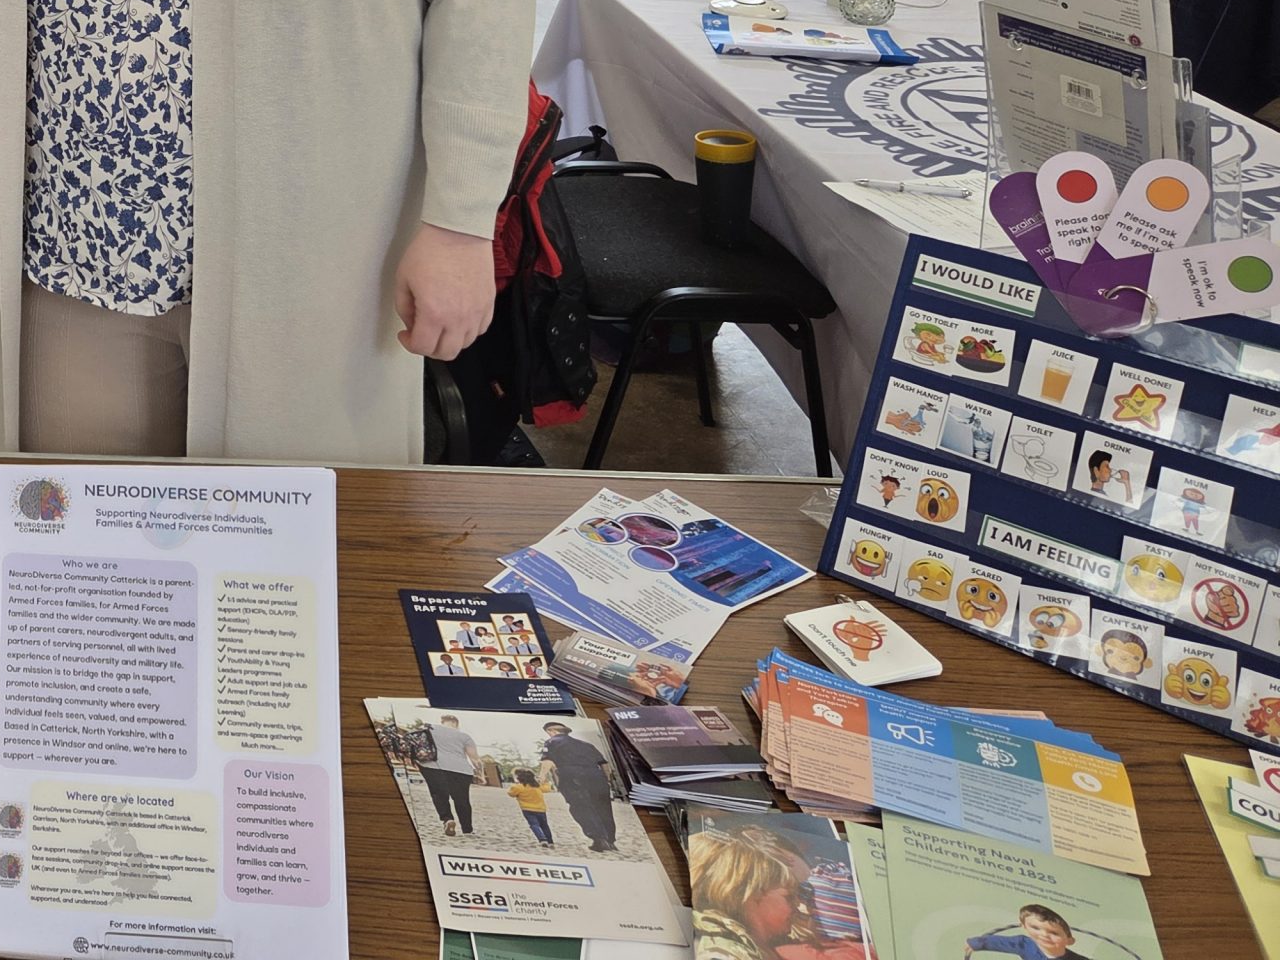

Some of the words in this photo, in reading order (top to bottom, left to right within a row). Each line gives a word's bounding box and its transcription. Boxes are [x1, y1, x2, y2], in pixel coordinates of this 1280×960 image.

[1124, 211, 1158, 233] Please
[1159, 226, 1178, 239] ask
[1116, 220, 1132, 233] me
[1160, 238, 1175, 250] ok
[920, 260, 926, 272] I
[932, 263, 994, 290] WOULD
[999, 282, 1035, 302] LIKE
[1183, 258, 1200, 287] speak
[1192, 289, 1204, 308] now
[1202, 279, 1214, 295] ok
[909, 311, 920, 319] GO
[922, 314, 932, 322] TO
[934, 317, 959, 329] TOILET
[971, 327, 994, 336] MORE
[1051, 350, 1074, 361] JUICE
[1120, 369, 1142, 382] WELL
[1143, 376, 1172, 389] DONE!
[893, 381, 916, 392] WASH
[916, 388, 944, 403] HANDS
[965, 402, 992, 417] WATER
[1252, 406, 1276, 417] HELP
[1027, 424, 1054, 438] TOILET
[1104, 441, 1132, 455] DRINK
[870, 453, 893, 465] DON'T
[895, 461, 919, 473] KNOW
[927, 469, 948, 479] LOUD
[84, 484, 208, 502] NEURODIVERSE
[212, 489, 312, 506] COMMUNITY
[95, 508, 147, 521] Supporting
[149, 510, 212, 522] Neurodiverse
[214, 513, 267, 525] Individuals,
[95, 519, 133, 529] Families
[135, 520, 143, 529] &
[145, 521, 176, 531] Armed
[178, 522, 210, 532] Forces
[212, 524, 273, 536] Communities
[859, 526, 893, 543] HUNGRY
[927, 549, 944, 561] SAD
[990, 526, 998, 541] I
[1001, 530, 1032, 553] AM
[1036, 541, 1112, 580] FEELING
[62, 559, 83, 568] Who
[102, 562, 118, 570] are
[970, 567, 1003, 583] SCARED
[1195, 562, 1213, 572] NOT
[1215, 568, 1236, 580] YOUR
[1237, 577, 1260, 589] TURN
[223, 580, 249, 590] What
[251, 583, 266, 591] we
[268, 582, 294, 593] offer
[411, 595, 426, 603] Be
[429, 596, 452, 606] part
[1036, 594, 1073, 607] THIRSTY
[439, 606, 477, 616] Family
[1184, 647, 1214, 660] HAPPY
[614, 711, 640, 720] NHS
[244, 769, 262, 780] Our
[264, 770, 294, 781] Vision
[902, 825, 987, 856] Supporting
[991, 849, 1036, 867] Naval
[903, 836, 970, 861] Children
[973, 856, 1014, 873] since
[1018, 867, 1057, 885] 1825
[448, 861, 494, 874] WHO
[500, 865, 531, 877] WE
[537, 868, 583, 881] HELP
[448, 891, 508, 907] ssafa
